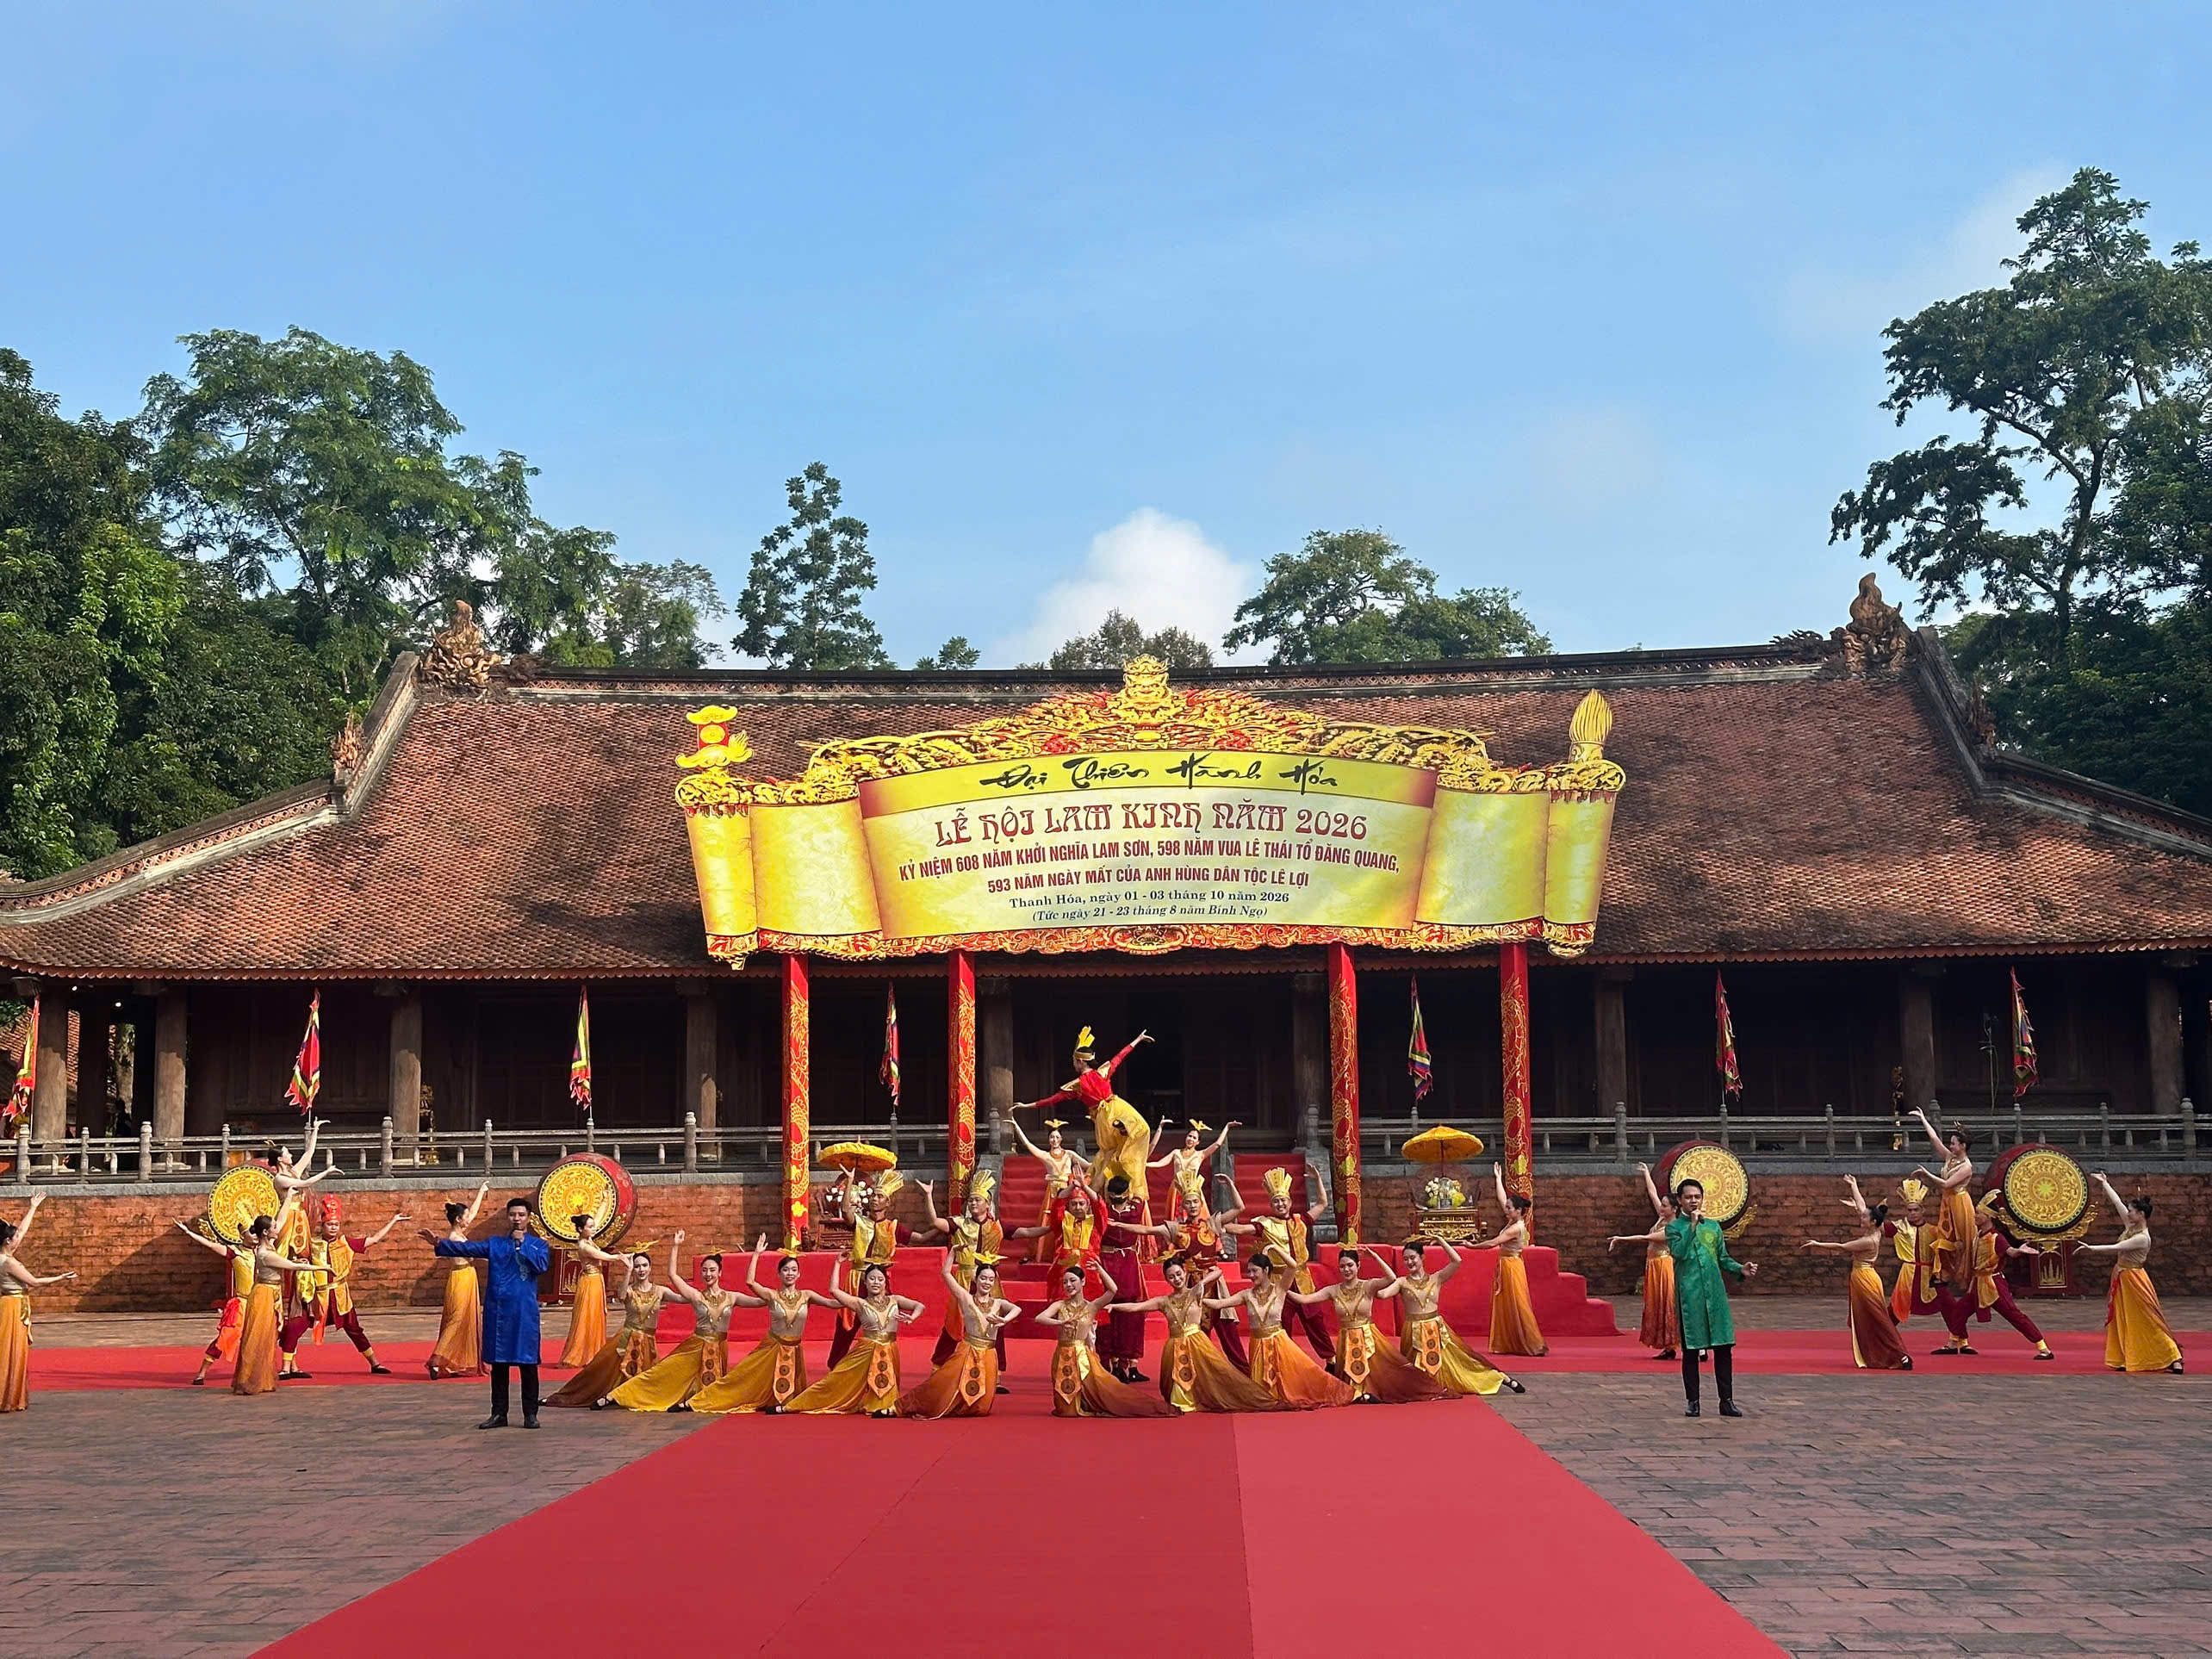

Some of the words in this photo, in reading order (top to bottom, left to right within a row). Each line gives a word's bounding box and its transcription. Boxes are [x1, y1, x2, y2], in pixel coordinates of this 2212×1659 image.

[979, 764, 1047, 790] Đại
[1062, 756, 1150, 789] Thiên
[1165, 752, 1262, 790] Hành
[1278, 758, 1338, 795] Hóa
[935, 807, 972, 847] LỄ
[979, 805, 1035, 844] HỘI
[1044, 804, 1113, 834] LAM
[1122, 803, 1202, 834] KINH
[1211, 798, 1288, 832] NĂM
[1295, 809, 1368, 840] 2026
[899, 859, 916, 881] KỶ
[919, 857, 953, 879] NIỆM
[956, 854, 979, 873] 608
[983, 848, 1013, 869] NĂM
[1016, 842, 1046, 865] KHỞI
[1049, 841, 1089, 862] NGHĨA
[1092, 842, 1120, 859] LAM
[1123, 839, 1154, 859] SƠN,
[1158, 840, 1181, 856] 598
[1184, 836, 1215, 856] NĂM
[1218, 840, 1242, 857] VUA
[1246, 837, 1260, 858] LÊ
[1264, 839, 1292, 860] THÁI
[1296, 838, 1314, 861] TỔ
[1314, 843, 1351, 865] ĐĂNG
[1353, 849, 1400, 874] QUANG,
[987, 878, 1011, 893] 593
[1015, 873, 1044, 891] NĂM
[1047, 869, 1082, 887] NGÀY
[1085, 864, 1113, 884] MẤT
[1115, 863, 1141, 882] CỦA
[1145, 867, 1171, 881] ANH
[1175, 865, 1210, 881] HÙNG
[1214, 866, 1240, 882] DÂN
[1244, 867, 1268, 886] TỘC
[1271, 868, 1285, 885] LÊ
[1289, 871, 1310, 890] LỢI
[1009, 896, 1052, 908] Thanh
[1056, 894, 1086, 905] Hóa,
[1090, 892, 1121, 904] ngày
[1124, 891, 1139, 901] 01
[1150, 890, 1165, 900] 03
[1168, 890, 1207, 902] tháng
[1210, 890, 1225, 900] 10
[1227, 892, 1257, 901] năm
[1259, 892, 1290, 903] 2026
[1032, 910, 1059, 922] (Tức
[1062, 909, 1090, 920] ngày
[1093, 907, 1106, 917] 21
[1116, 906, 1130, 916] 23
[1133, 904, 1168, 917] tháng
[1169, 904, 1177, 916] 8
[1178, 905, 1206, 916] năm
[1208, 904, 1237, 916] Bính
[1240, 905, 1269, 919] Ngọ)
